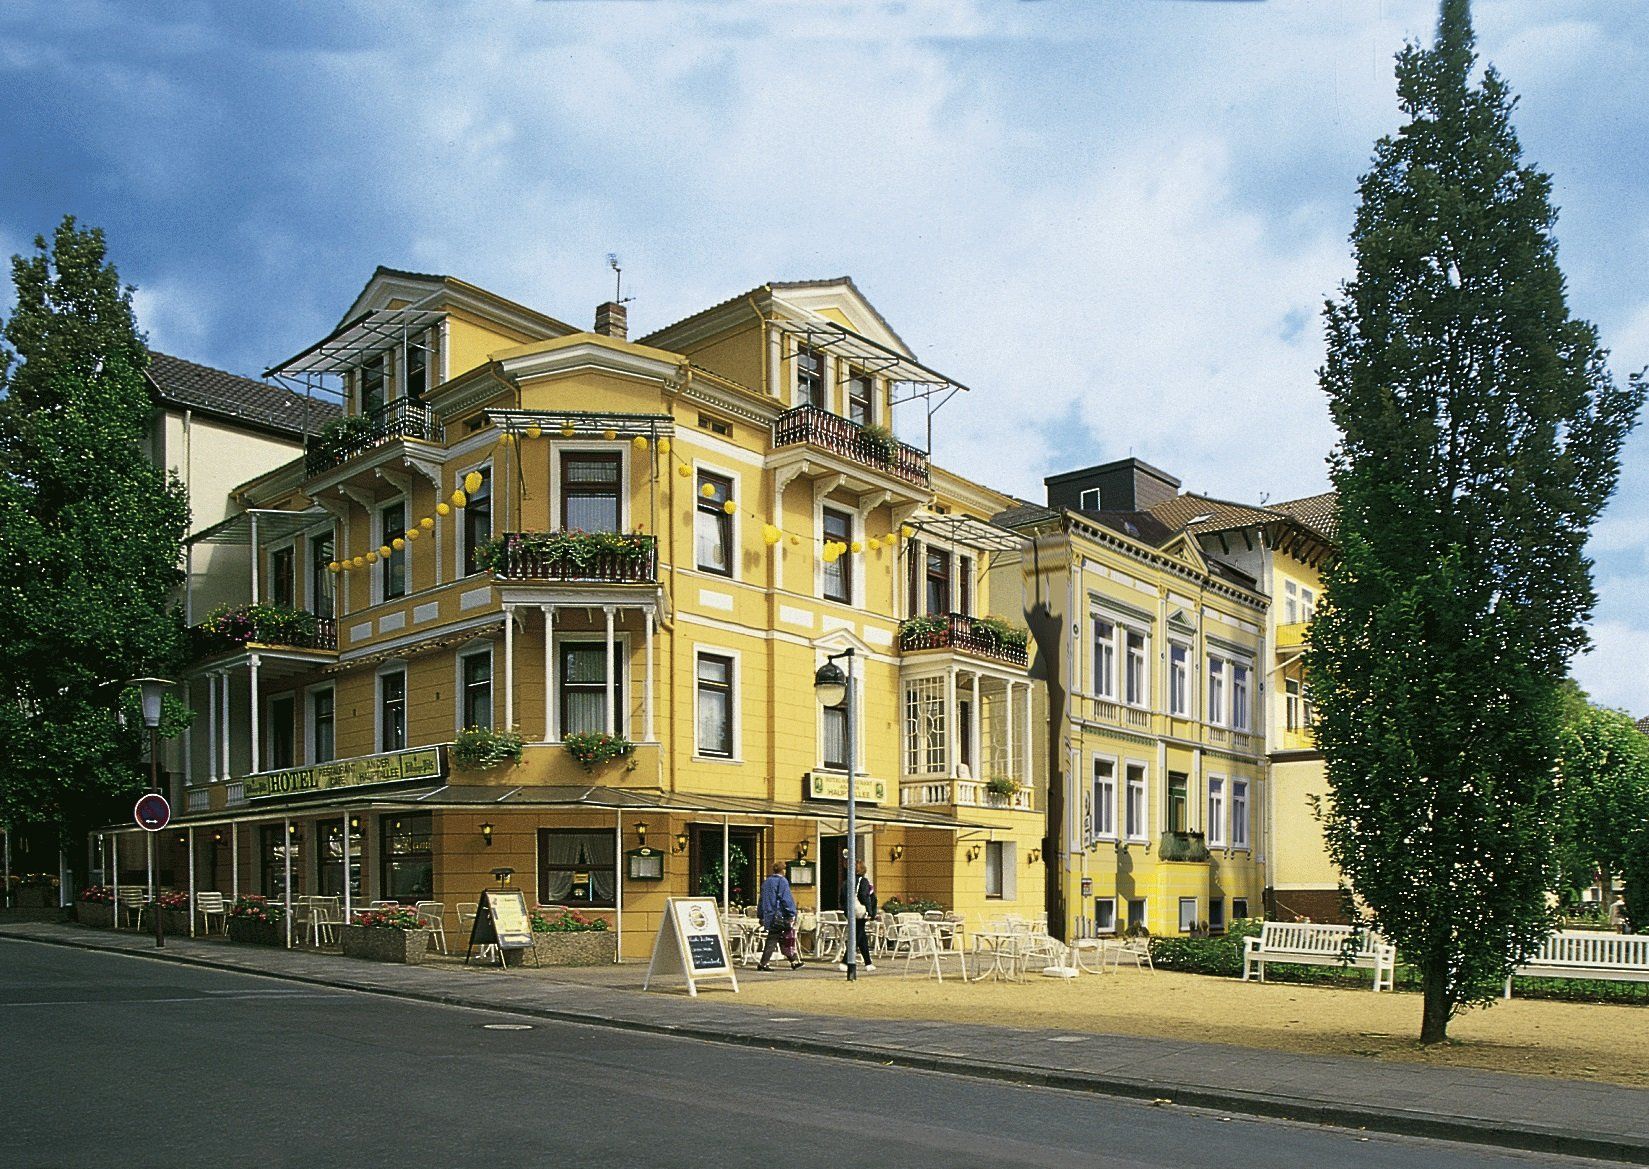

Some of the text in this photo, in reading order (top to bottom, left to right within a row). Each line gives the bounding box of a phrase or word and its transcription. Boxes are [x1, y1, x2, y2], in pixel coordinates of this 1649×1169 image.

[319, 763, 355, 777] RESTAURANT
[359, 767, 399, 781] HAUPTALLEE
[270, 769, 318, 793] HOTEL
